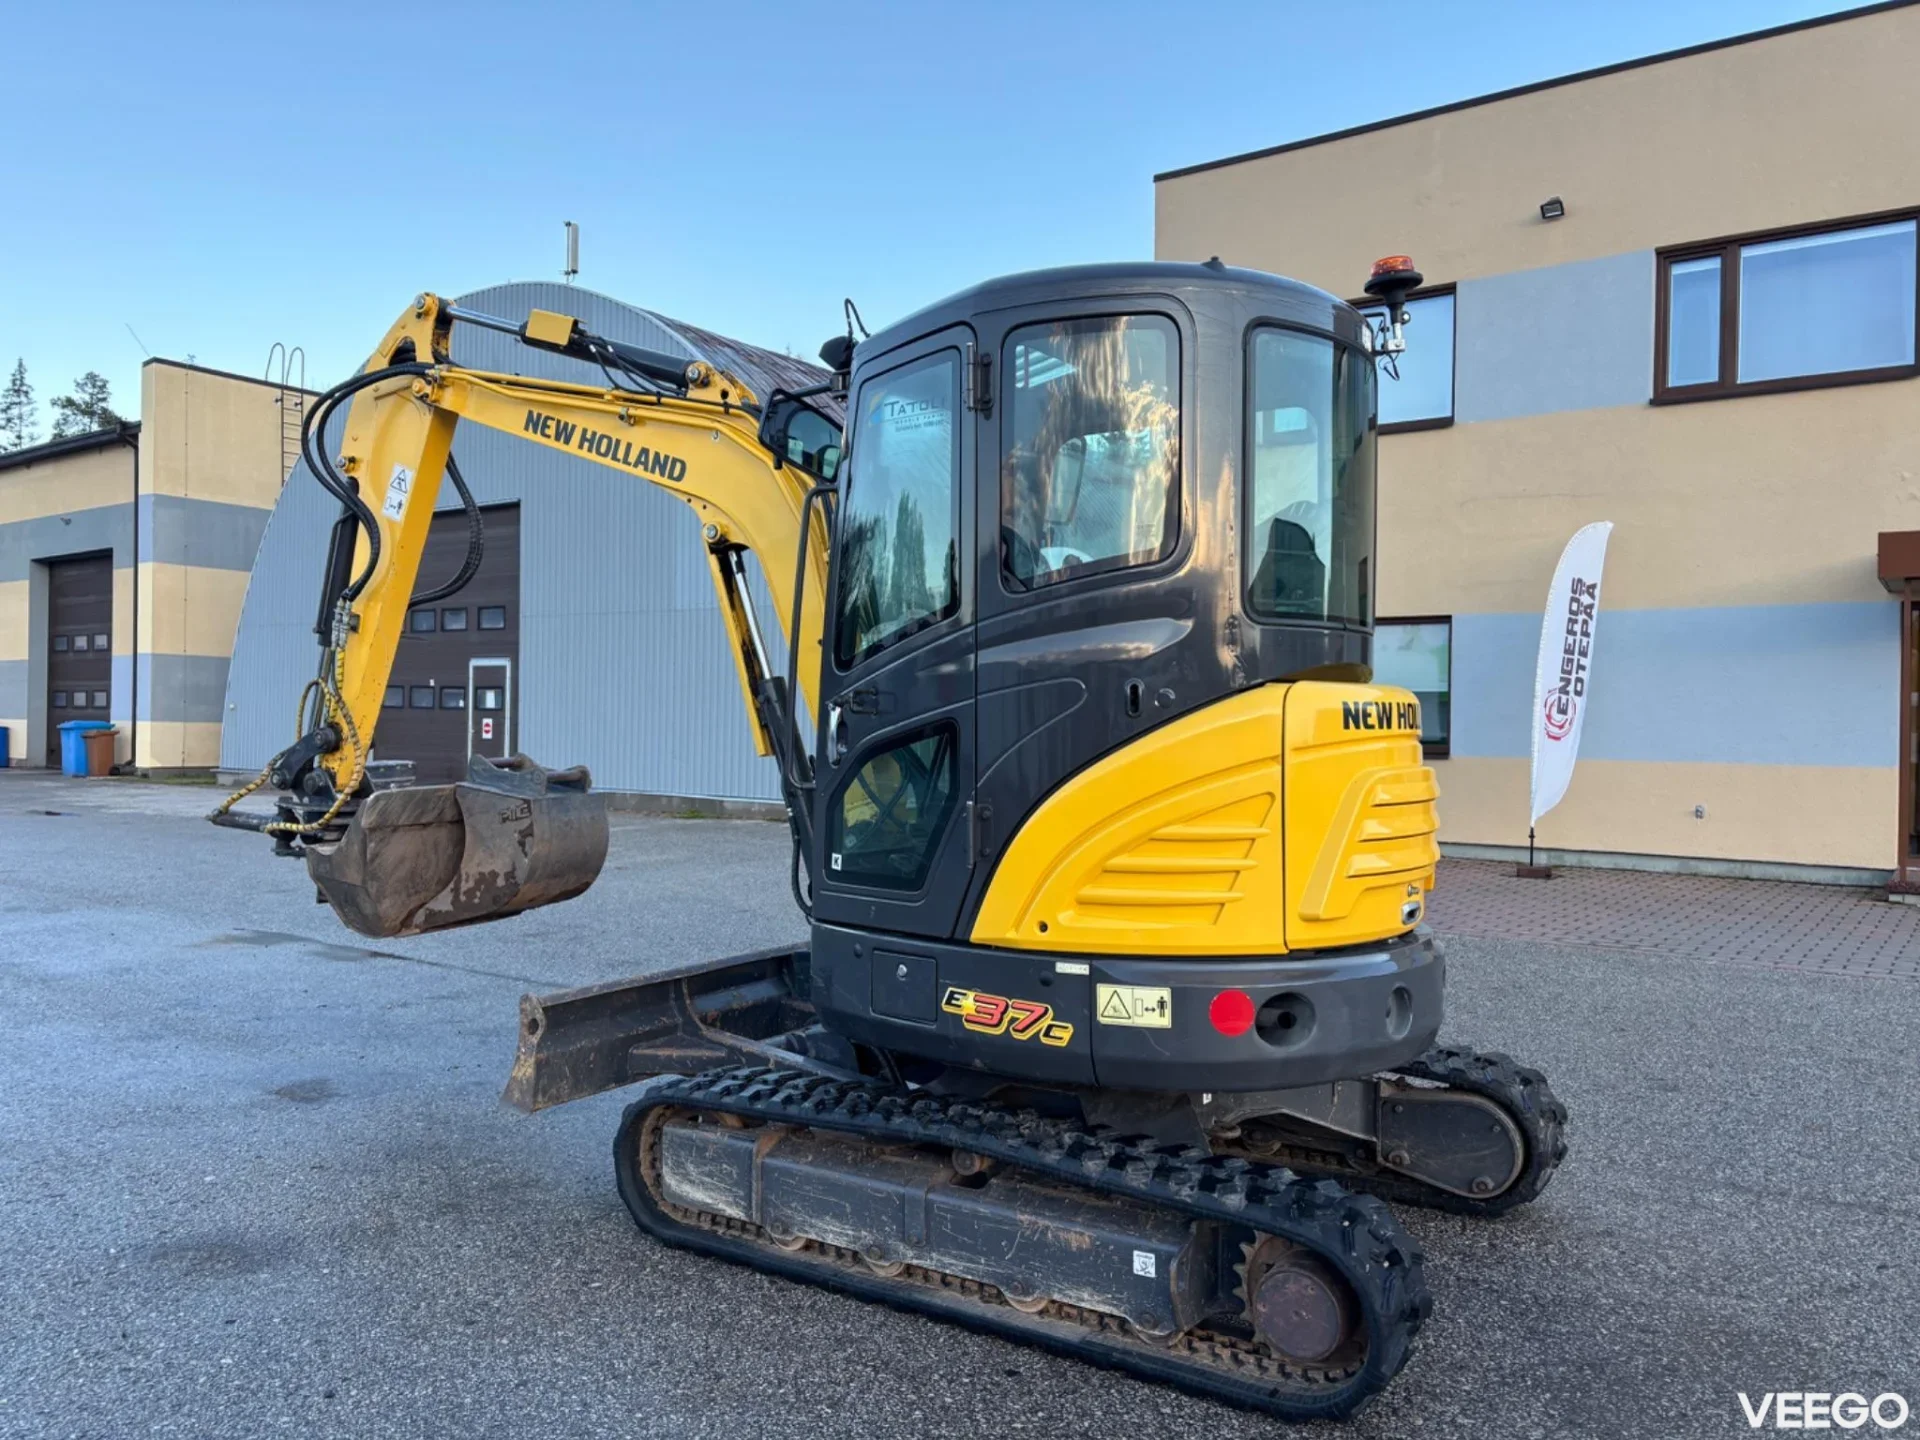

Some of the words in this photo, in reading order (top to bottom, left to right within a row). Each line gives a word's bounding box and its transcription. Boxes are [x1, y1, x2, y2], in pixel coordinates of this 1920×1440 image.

[523, 409, 577, 446] NEW
[578, 427, 687, 482] HOLLAND
[1557, 577, 1583, 716] ENGEROS
[1574, 582, 1597, 698] OTEPÄÄ
[1342, 701, 1393, 730] NEW
[942, 988, 1074, 1046] E37C
